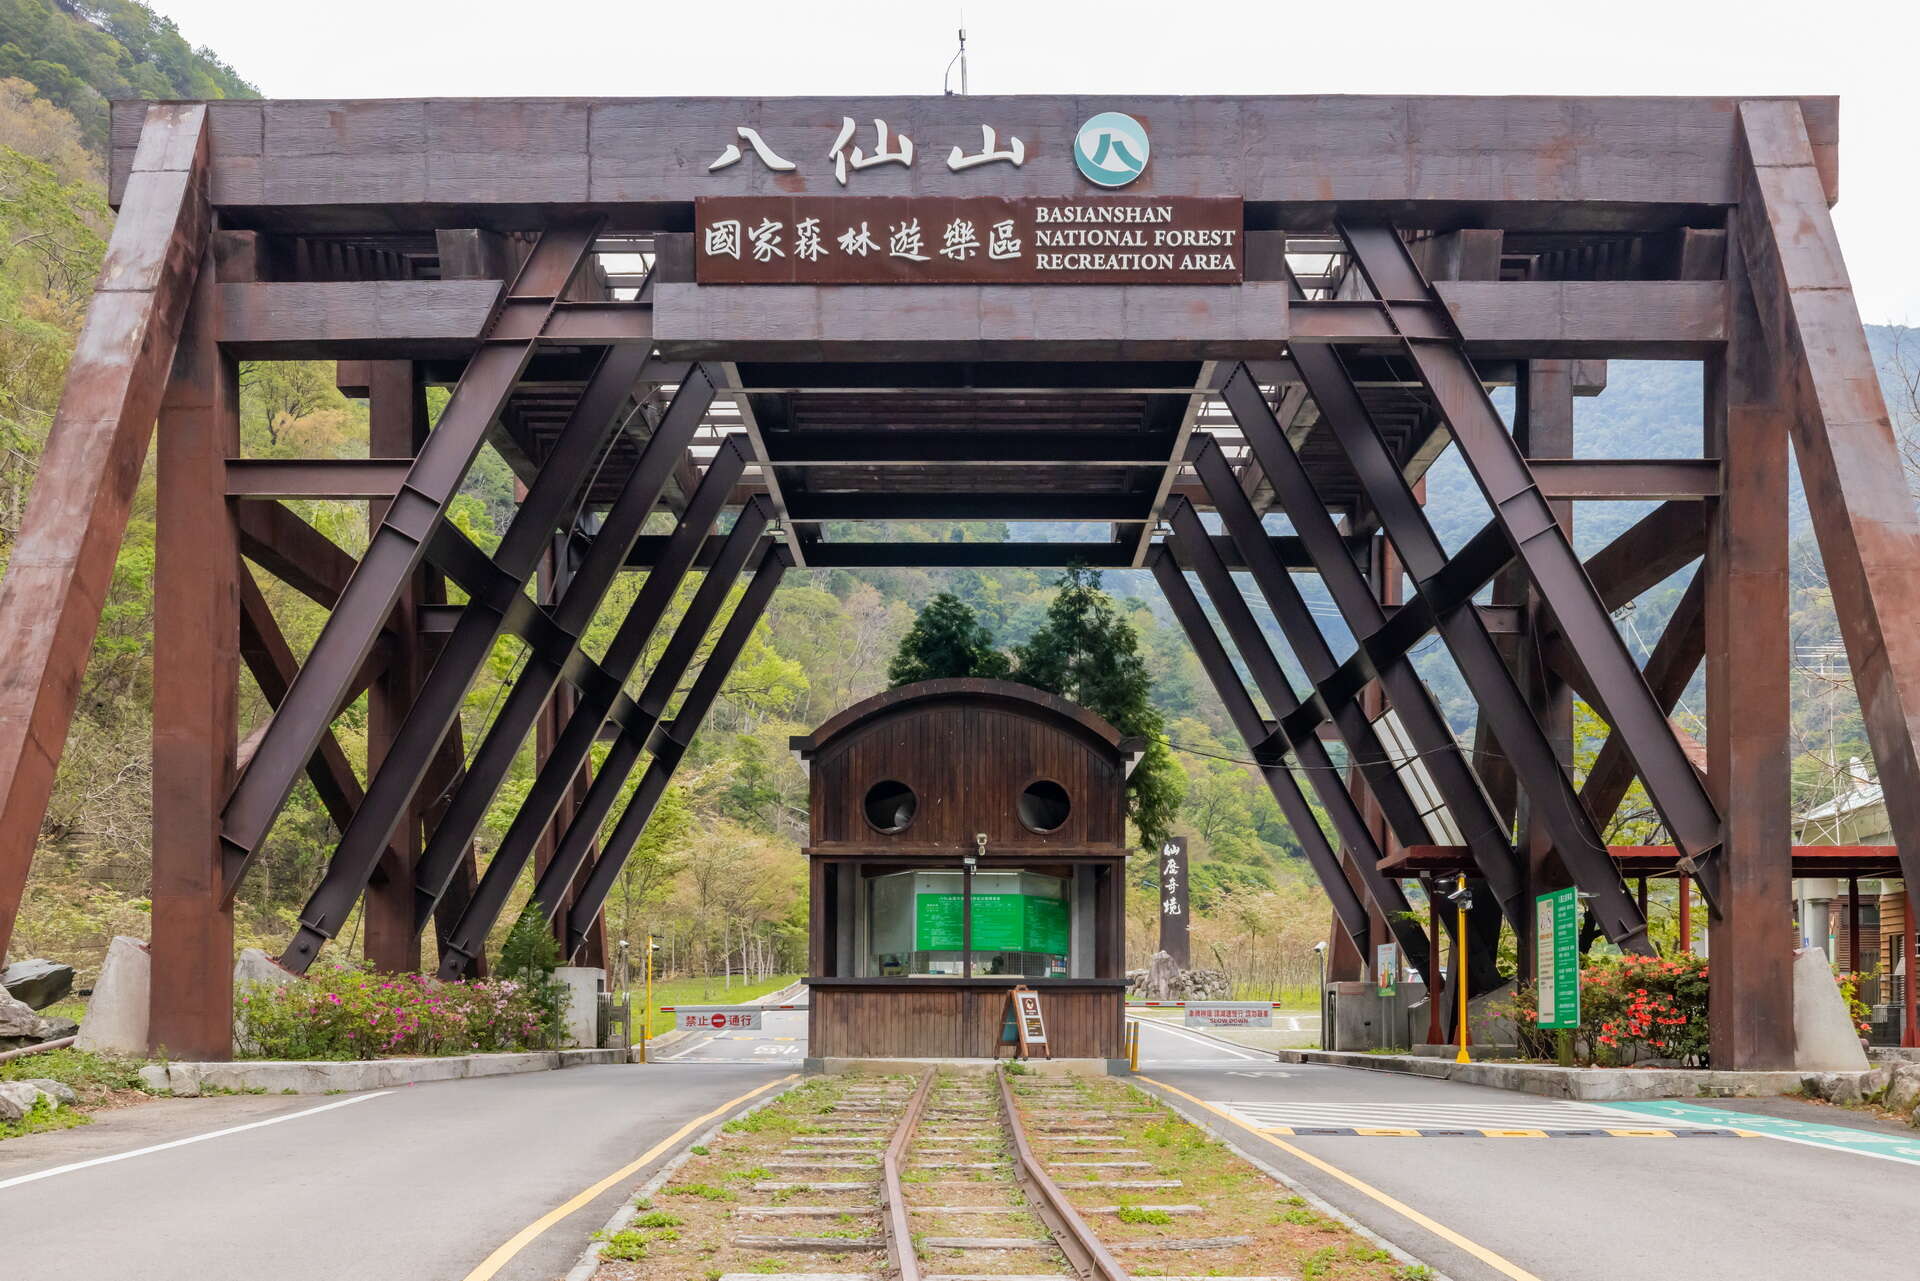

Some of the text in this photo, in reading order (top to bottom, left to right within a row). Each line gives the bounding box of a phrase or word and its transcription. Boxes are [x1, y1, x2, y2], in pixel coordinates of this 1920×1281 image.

[709, 116, 1025, 185] 八仙山
[1035, 206, 1173, 223] BASIANSHAN
[704, 216, 1023, 262] 國家森林遊樂區
[1035, 230, 1236, 247] NATIONAL FOREST
[1035, 254, 1236, 270] RECREATION AREA
[685, 1015, 752, 1027] 禁止 通行
